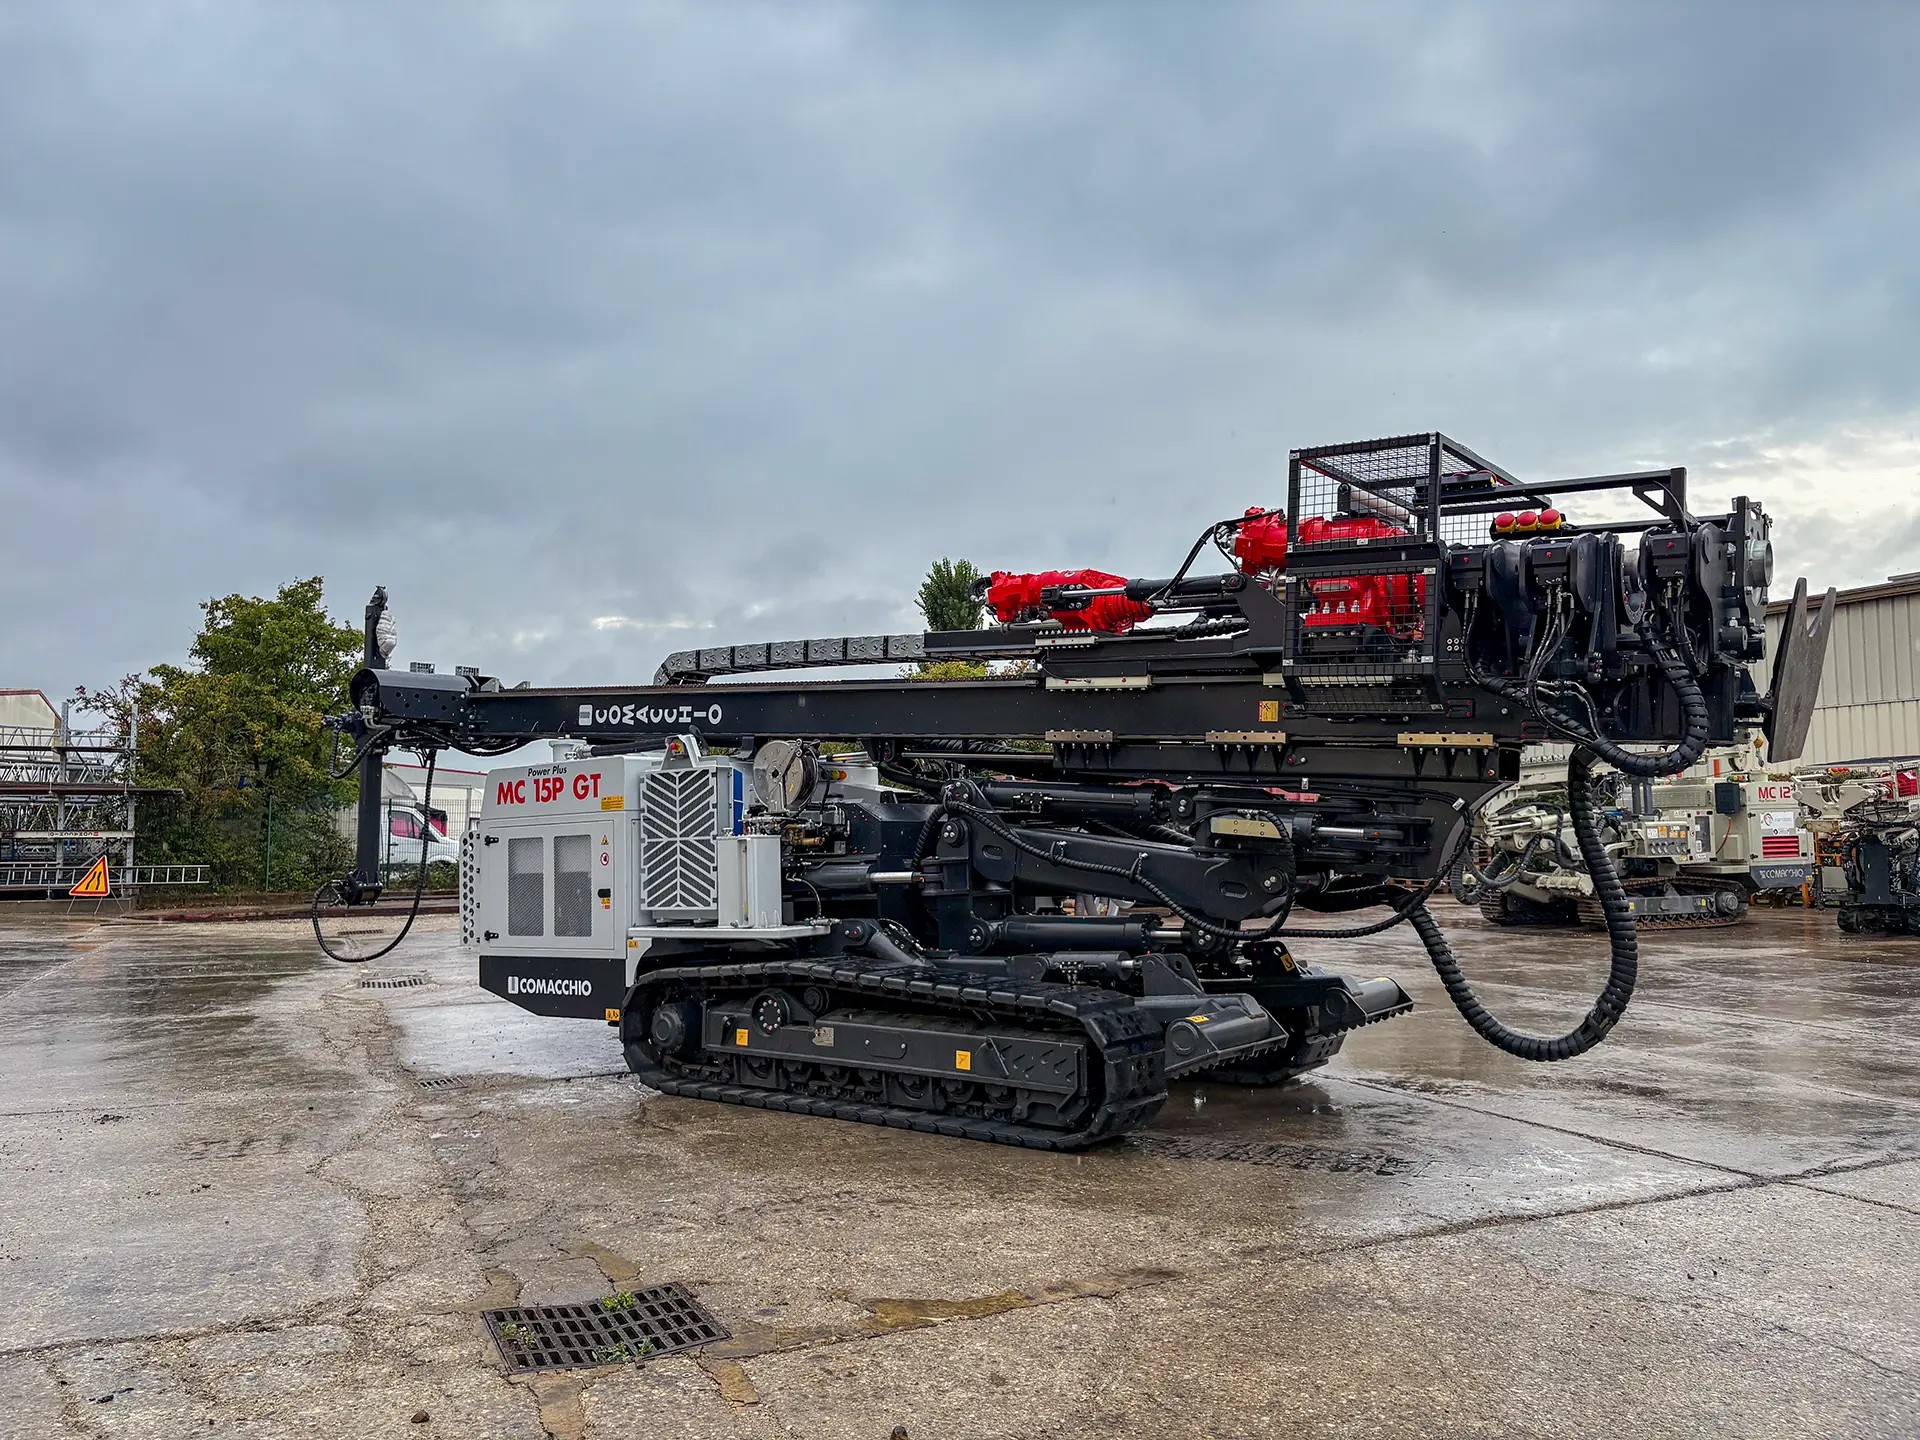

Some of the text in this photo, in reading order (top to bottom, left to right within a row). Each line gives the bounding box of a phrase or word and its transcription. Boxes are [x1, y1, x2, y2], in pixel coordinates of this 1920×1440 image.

[595, 703, 722, 725] COMACCHIO
[527, 764, 568, 777] Power Plus
[497, 773, 602, 805] MC 15P GT
[1758, 786, 1791, 799] MC 12
[520, 978, 592, 996] COMACCHIO
